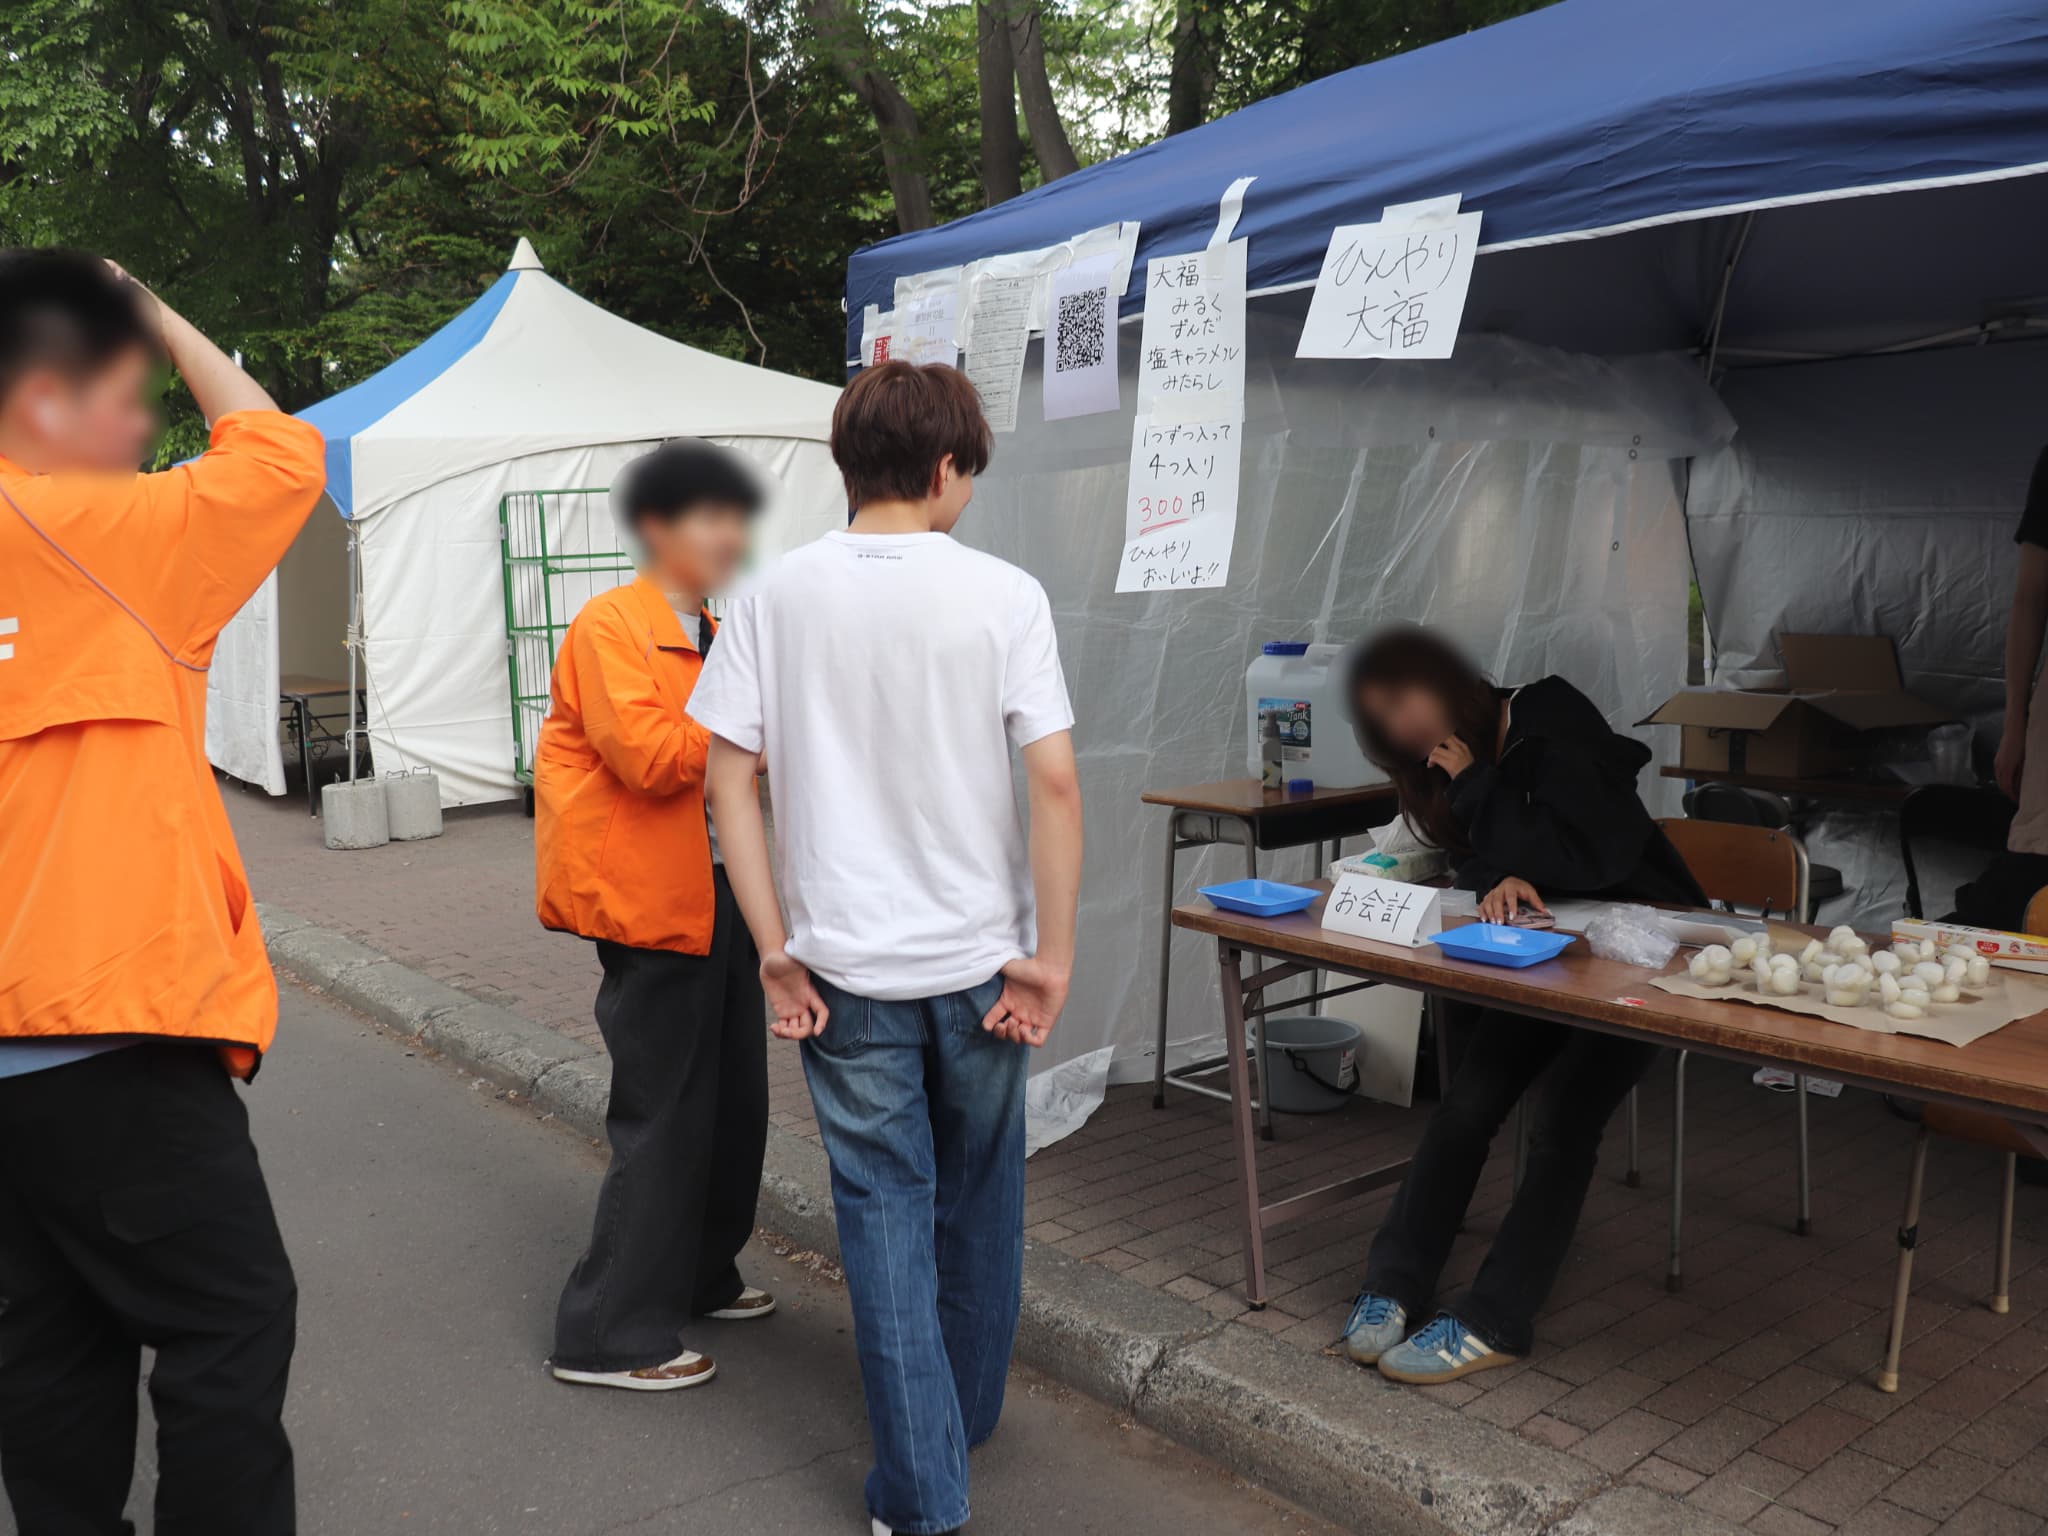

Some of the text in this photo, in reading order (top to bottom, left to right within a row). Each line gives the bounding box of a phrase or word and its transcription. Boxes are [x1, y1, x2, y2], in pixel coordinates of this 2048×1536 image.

[1152, 258, 1200, 289] 大福
[1330, 233, 1458, 290] ひんやり
[1171, 292, 1223, 316] みるく
[1170, 317, 1222, 339] ずんだ
[1343, 290, 1430, 350] 大福
[1146, 342, 1240, 371] 塩キャラメル
[1162, 374, 1224, 393] みたらし
[1143, 424, 1231, 448] 1つずつ入って
[1148, 453, 1215, 480] 4つ入り
[1138, 490, 1205, 523] 300円
[1129, 539, 1191, 563] ひんやり
[1335, 885, 1414, 934] お会計
